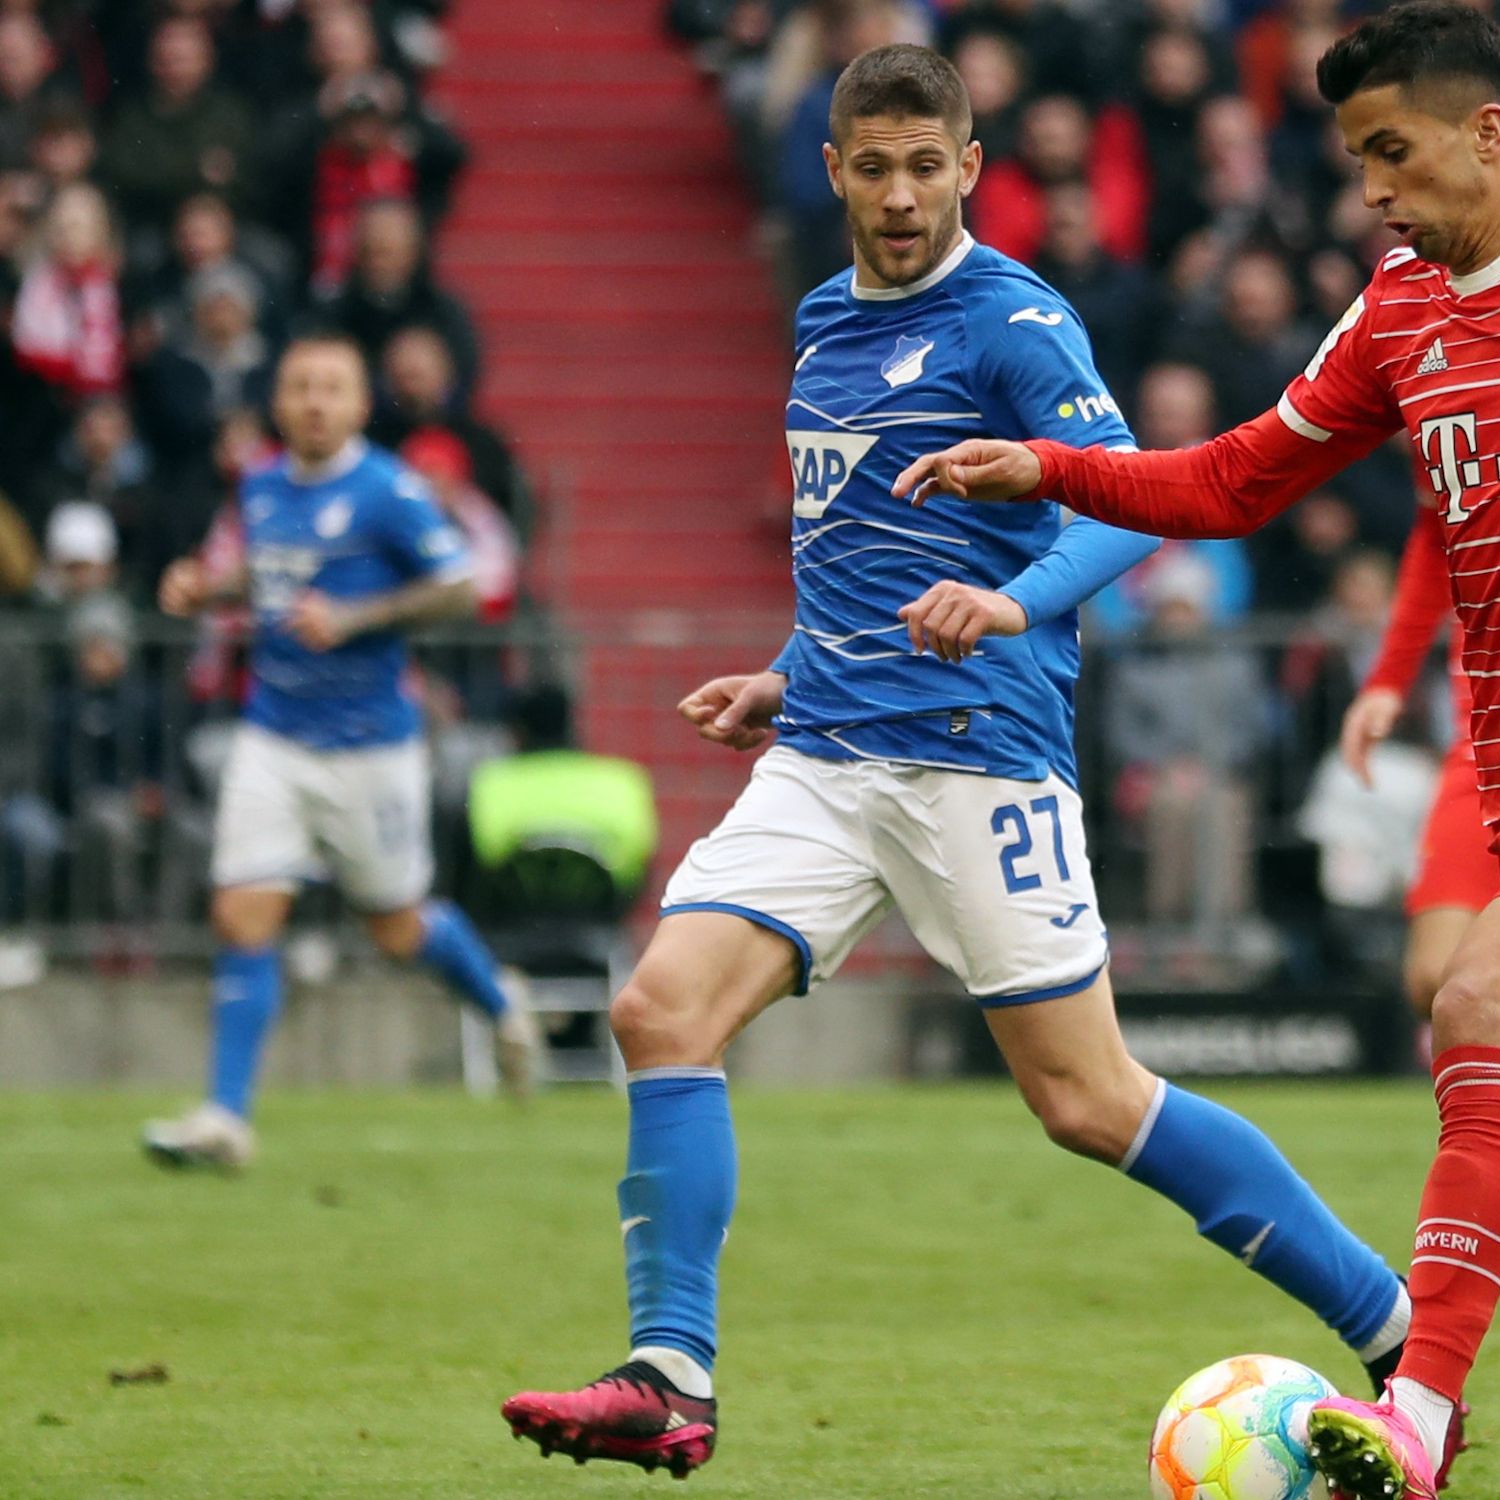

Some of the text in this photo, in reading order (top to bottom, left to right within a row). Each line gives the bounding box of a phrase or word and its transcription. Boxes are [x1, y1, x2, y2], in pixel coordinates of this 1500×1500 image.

[1417, 358, 1448, 374] adidas
[990, 795, 1070, 894] 27
[1415, 1231, 1479, 1256] BAYERN
